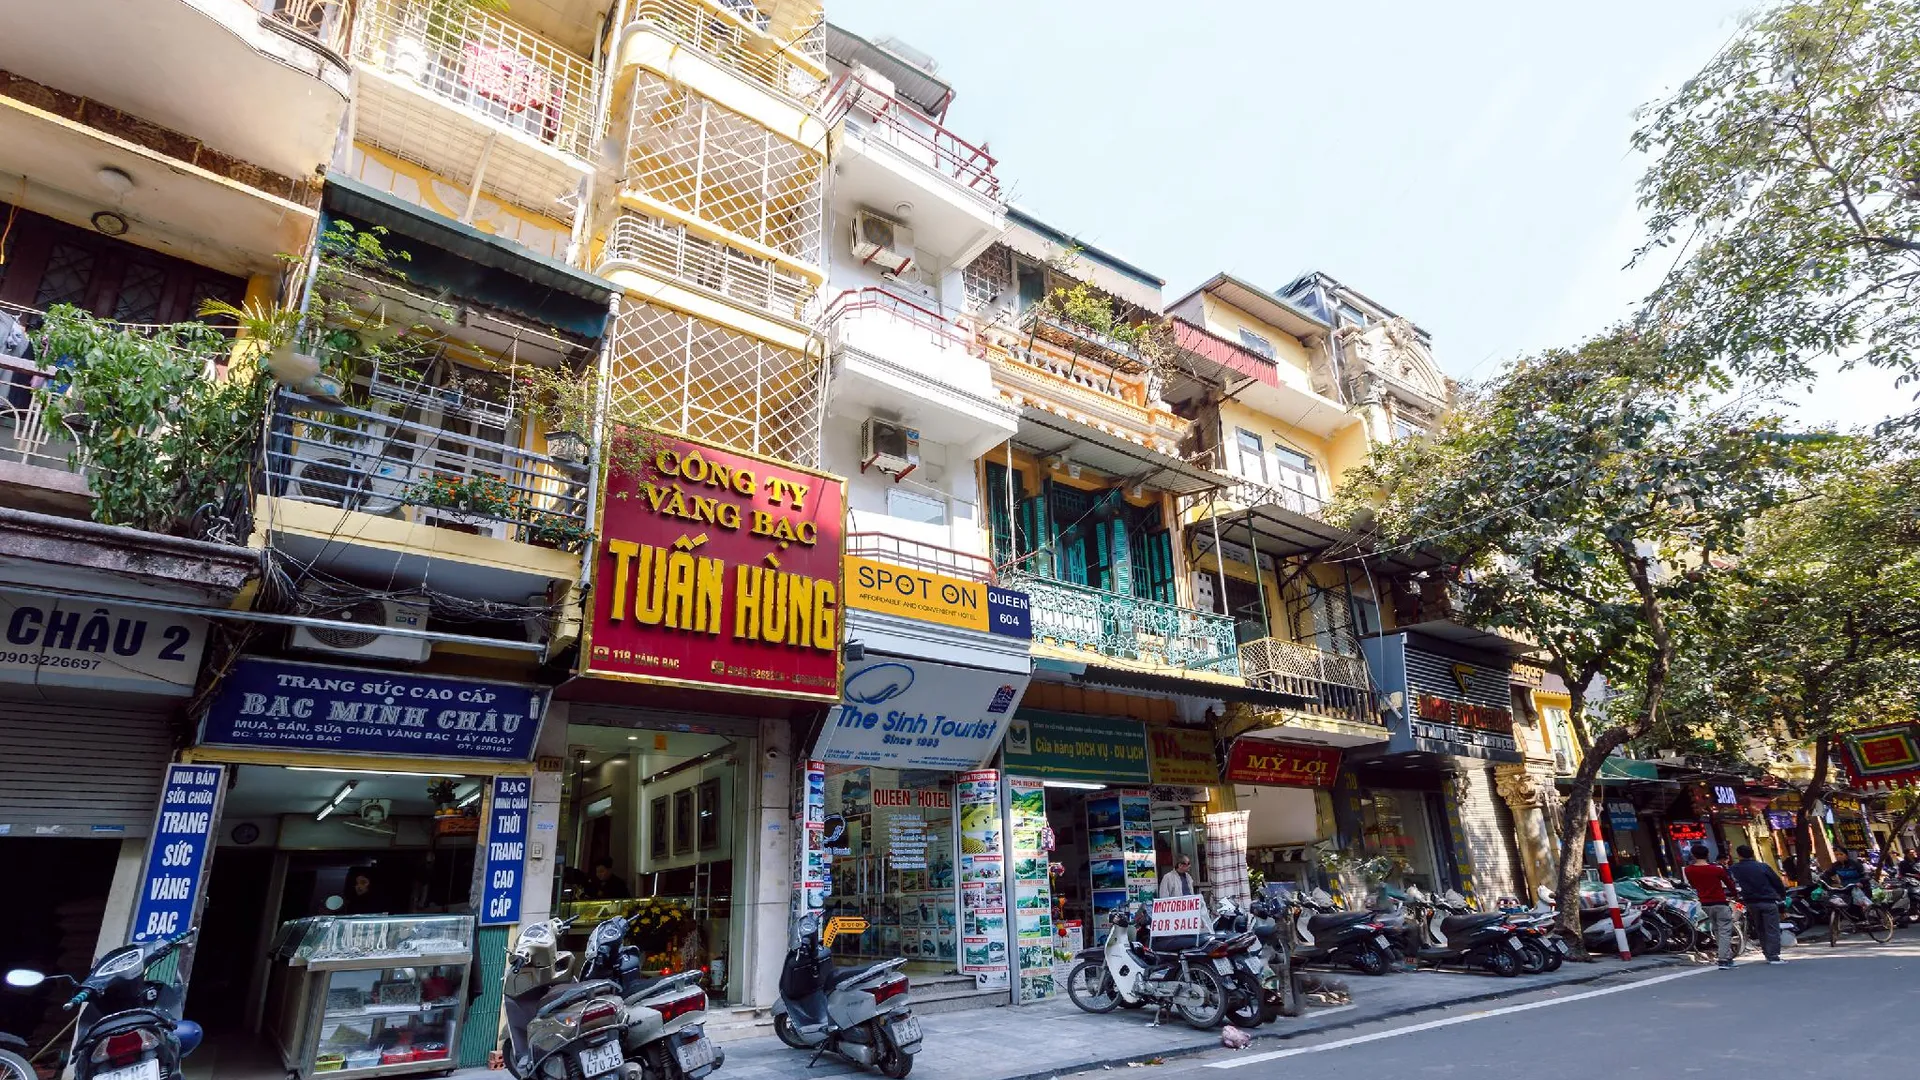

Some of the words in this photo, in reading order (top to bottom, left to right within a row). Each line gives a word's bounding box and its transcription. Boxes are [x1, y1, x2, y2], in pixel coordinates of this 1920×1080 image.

[655, 450, 758, 496] CÔNG
[765, 476, 809, 509] TY
[646, 483, 742, 530] VÀNG
[752, 509, 817, 550] BẠC
[609, 533, 724, 634] TUẤN
[733, 552, 836, 651] HÙNG
[858, 566, 932, 600] SPOT
[942, 584, 977, 609] ON
[859, 593, 901, 607] AFFORDABLE
[903, 601, 917, 610] AND
[918, 604, 957, 618] CONVENIENT
[988, 592, 1028, 610] QUEEN
[999, 613, 1020, 627] 604
[7, 608, 147, 657] CHÂU
[158, 625, 190, 662] 2
[277, 674, 356, 693] TRANG
[361, 681, 406, 696] SỨC
[410, 687, 453, 700] CAO
[458, 688, 497, 703] CẤP
[240, 692, 314, 720] BẠC
[437, 709, 524, 733] CHÂU
[838, 705, 879, 730] The
[882, 710, 928, 735] Sinh
[931, 715, 998, 740] Tourist
[280, 732, 314, 741] HÀNG
[387, 729, 422, 739] VÀNG
[481, 736, 515, 745] NGAY
[882, 734, 912, 746] Since
[1076, 740, 1096, 760] DỊCH
[1099, 744, 1108, 762] VỤ
[172, 771, 193, 785] MUA
[195, 769, 216, 786] BÁN
[500, 781, 526, 796] BẠC
[165, 787, 186, 804] SỬA
[187, 789, 213, 805] CHỮA
[494, 797, 511, 810] MINH
[511, 797, 528, 810] CHÂU
[873, 788, 911, 808] QUEEN
[917, 791, 951, 808] HOTEL
[161, 812, 209, 834] TRANG
[498, 812, 521, 834] THỜI
[162, 840, 194, 867] SỨC
[490, 842, 524, 861] TRANG
[150, 873, 192, 901] VÀNG
[493, 870, 515, 889] CAO
[490, 891, 512, 918] CẤP
[1154, 898, 1200, 913] MOTORBIKE
[146, 912, 179, 940] BẠC
[1152, 919, 1171, 932] FOR
[1174, 917, 1198, 931] SALE
